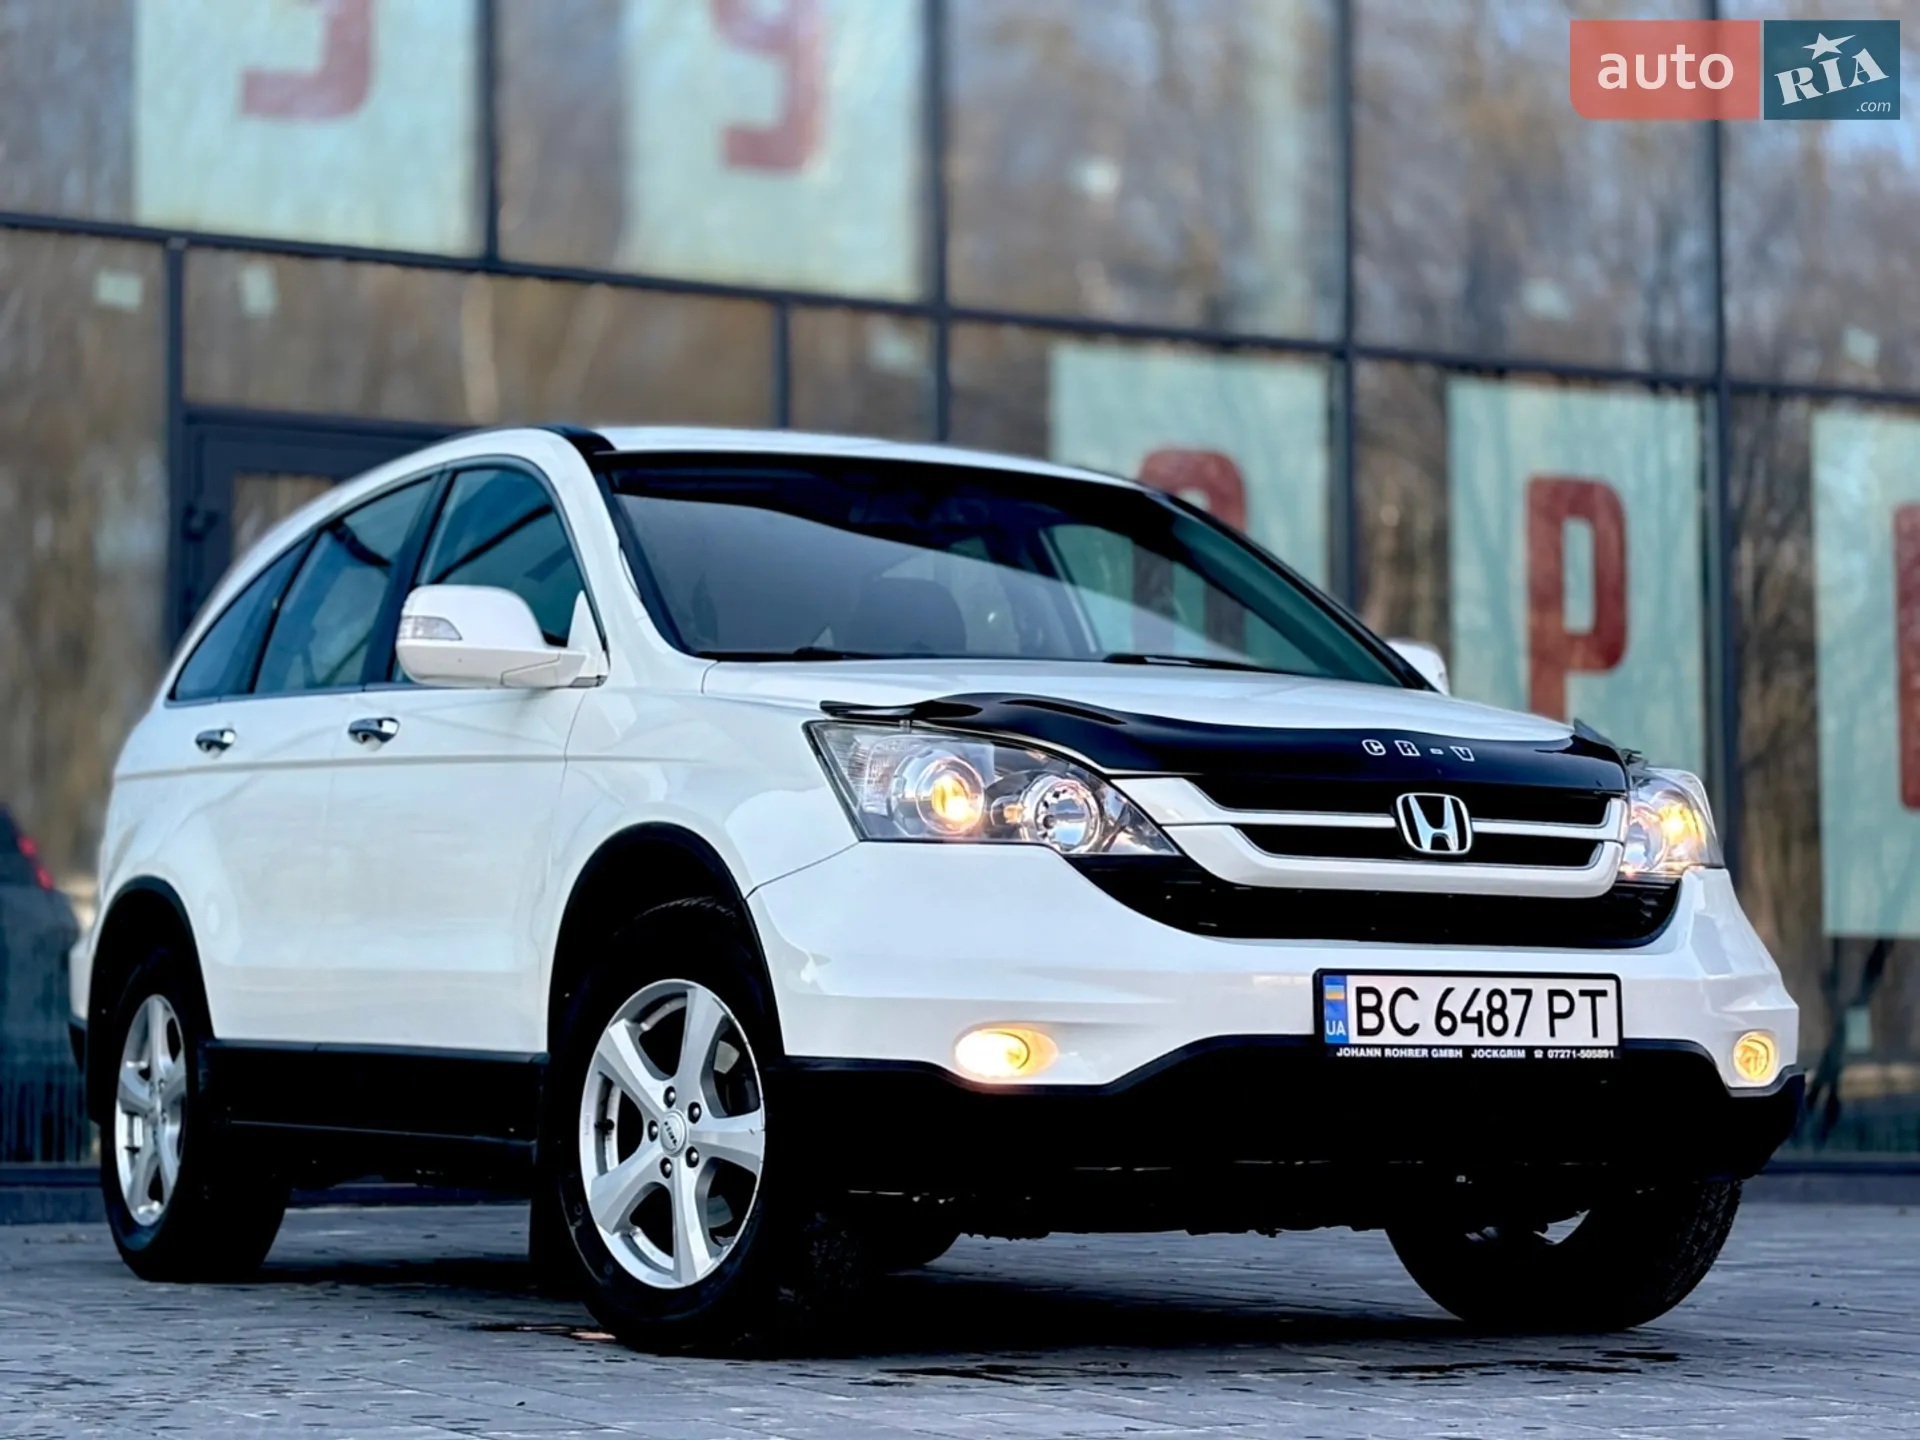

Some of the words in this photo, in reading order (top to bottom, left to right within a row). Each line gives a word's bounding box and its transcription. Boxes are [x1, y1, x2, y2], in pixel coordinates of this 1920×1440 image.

[1361, 738, 1476, 762] CR-V
[1355, 985, 1421, 1038] BC
[1434, 986, 1534, 1038] 6487
[1547, 988, 1609, 1039] PT
[1325, 1019, 1347, 1037] UA
[1336, 1047, 1382, 1058] JOHANN
[1384, 1047, 1429, 1059] ROHRER
